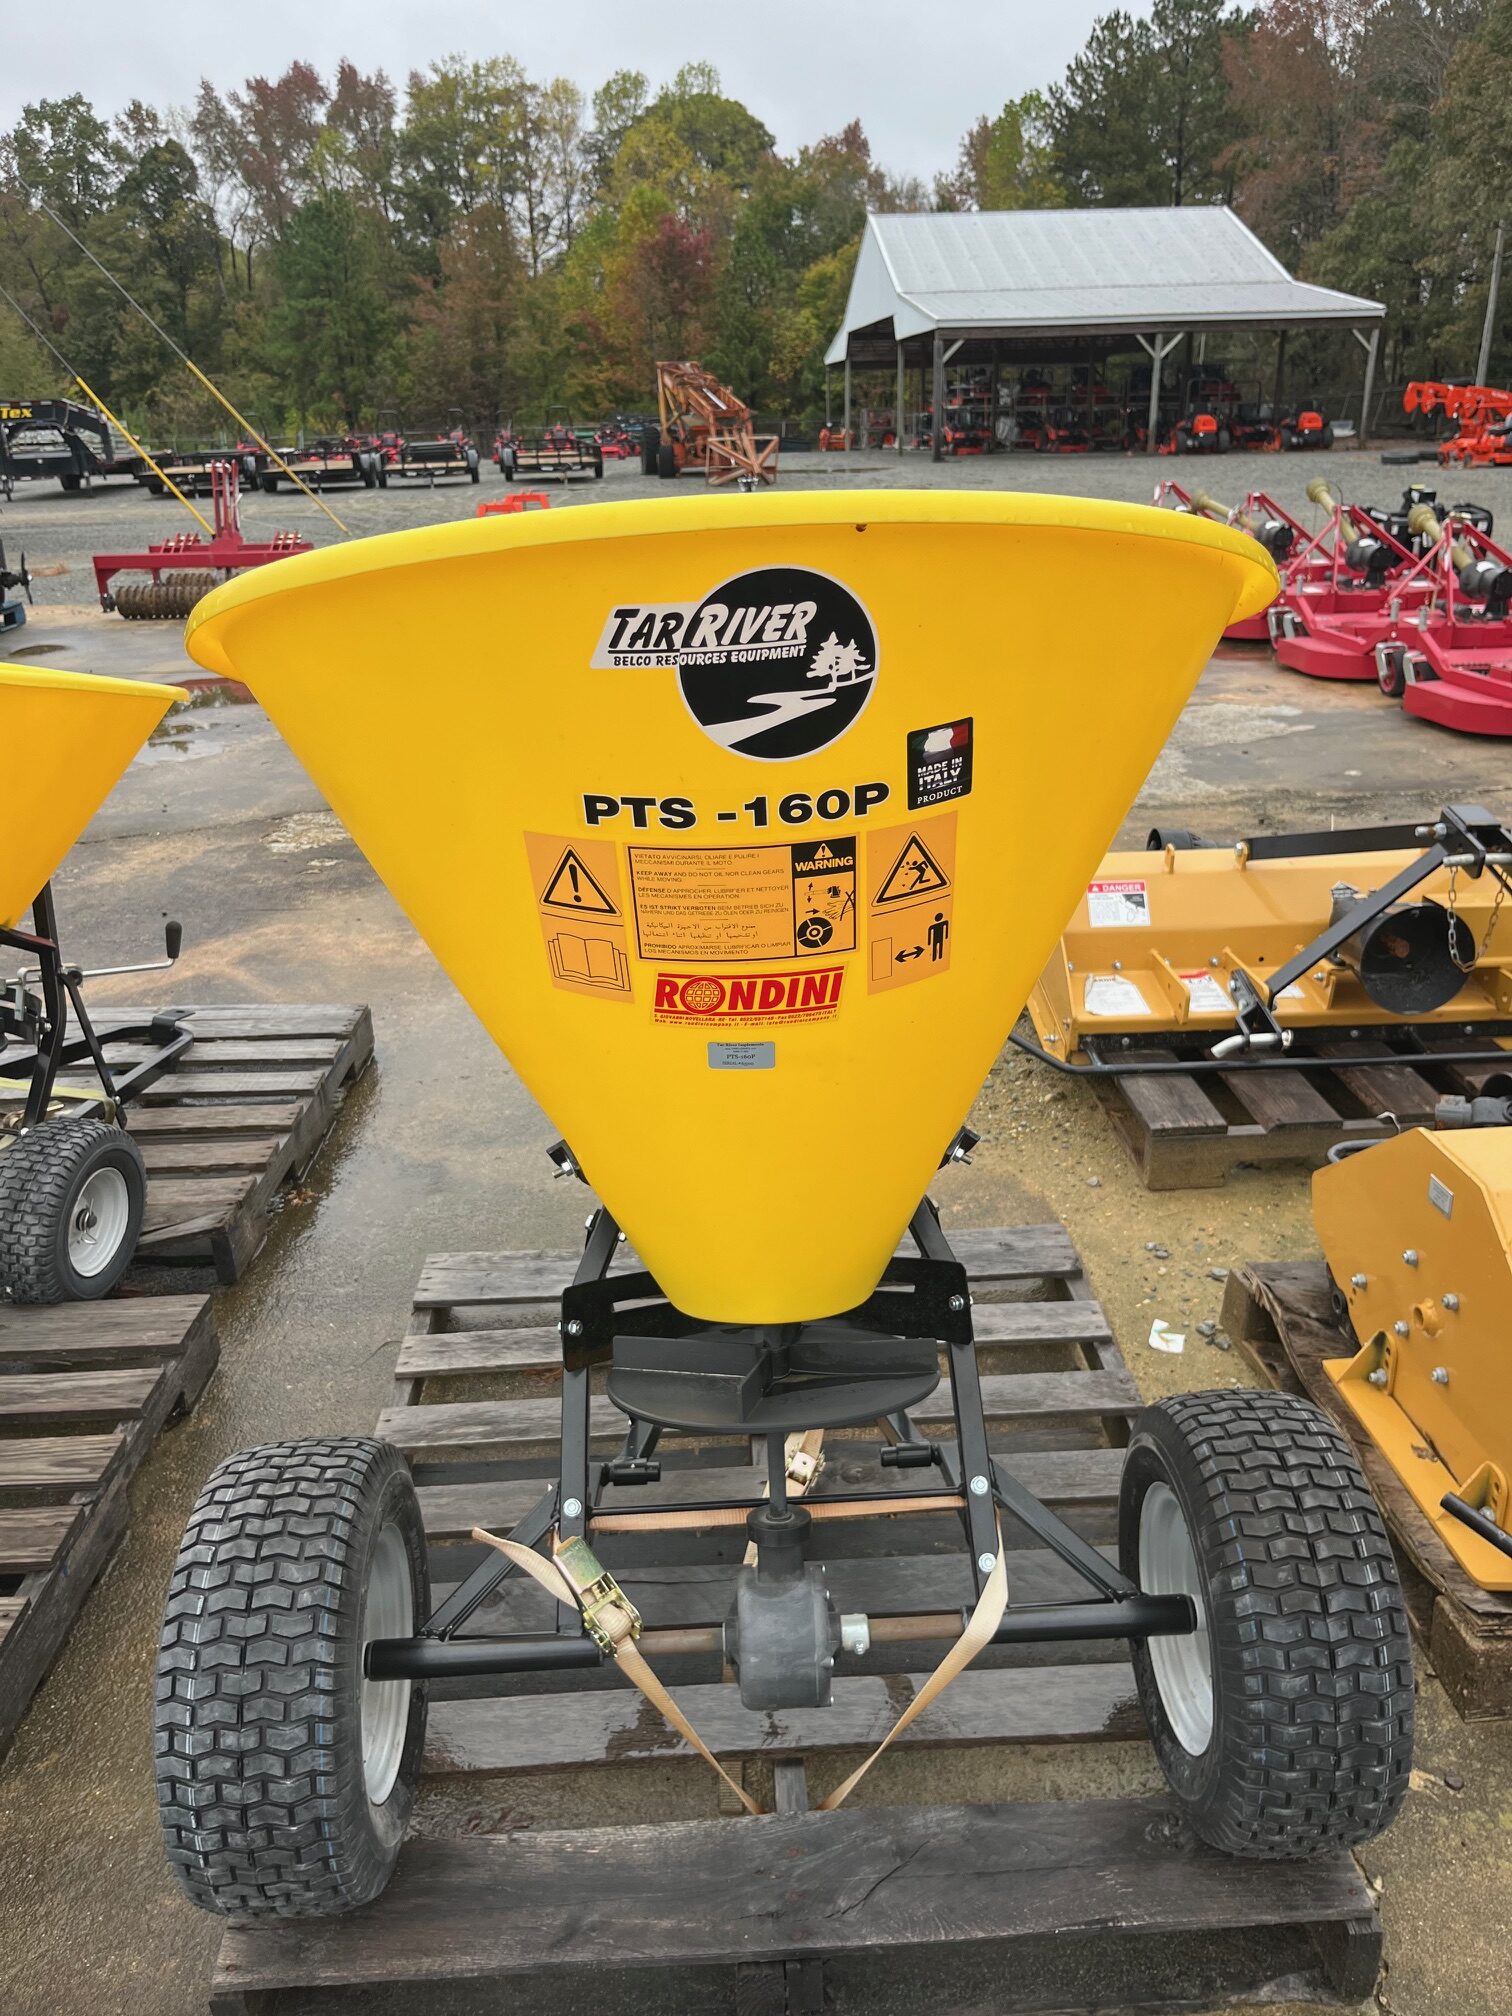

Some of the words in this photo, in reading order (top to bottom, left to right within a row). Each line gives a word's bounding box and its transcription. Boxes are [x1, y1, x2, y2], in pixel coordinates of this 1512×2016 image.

[0, 407, 32, 419] Tex
[690, 601, 817, 647] RIVER
[614, 656, 651, 666] BELCO
[653, 652, 728, 666] RESOURCES
[731, 645, 806, 664] EQUIPMENT
[918, 760, 948, 777] MADE
[952, 756, 962, 768] IN
[918, 768, 961, 790] ITALY
[917, 786, 963, 804] PRODUCT
[582, 794, 697, 830] PTS
[794, 856, 854, 872] WARNING
[1102, 884, 1141, 892] DANGER
[644, 942, 677, 950] PROHIBIDO
[654, 971, 844, 1015] RONDINI
